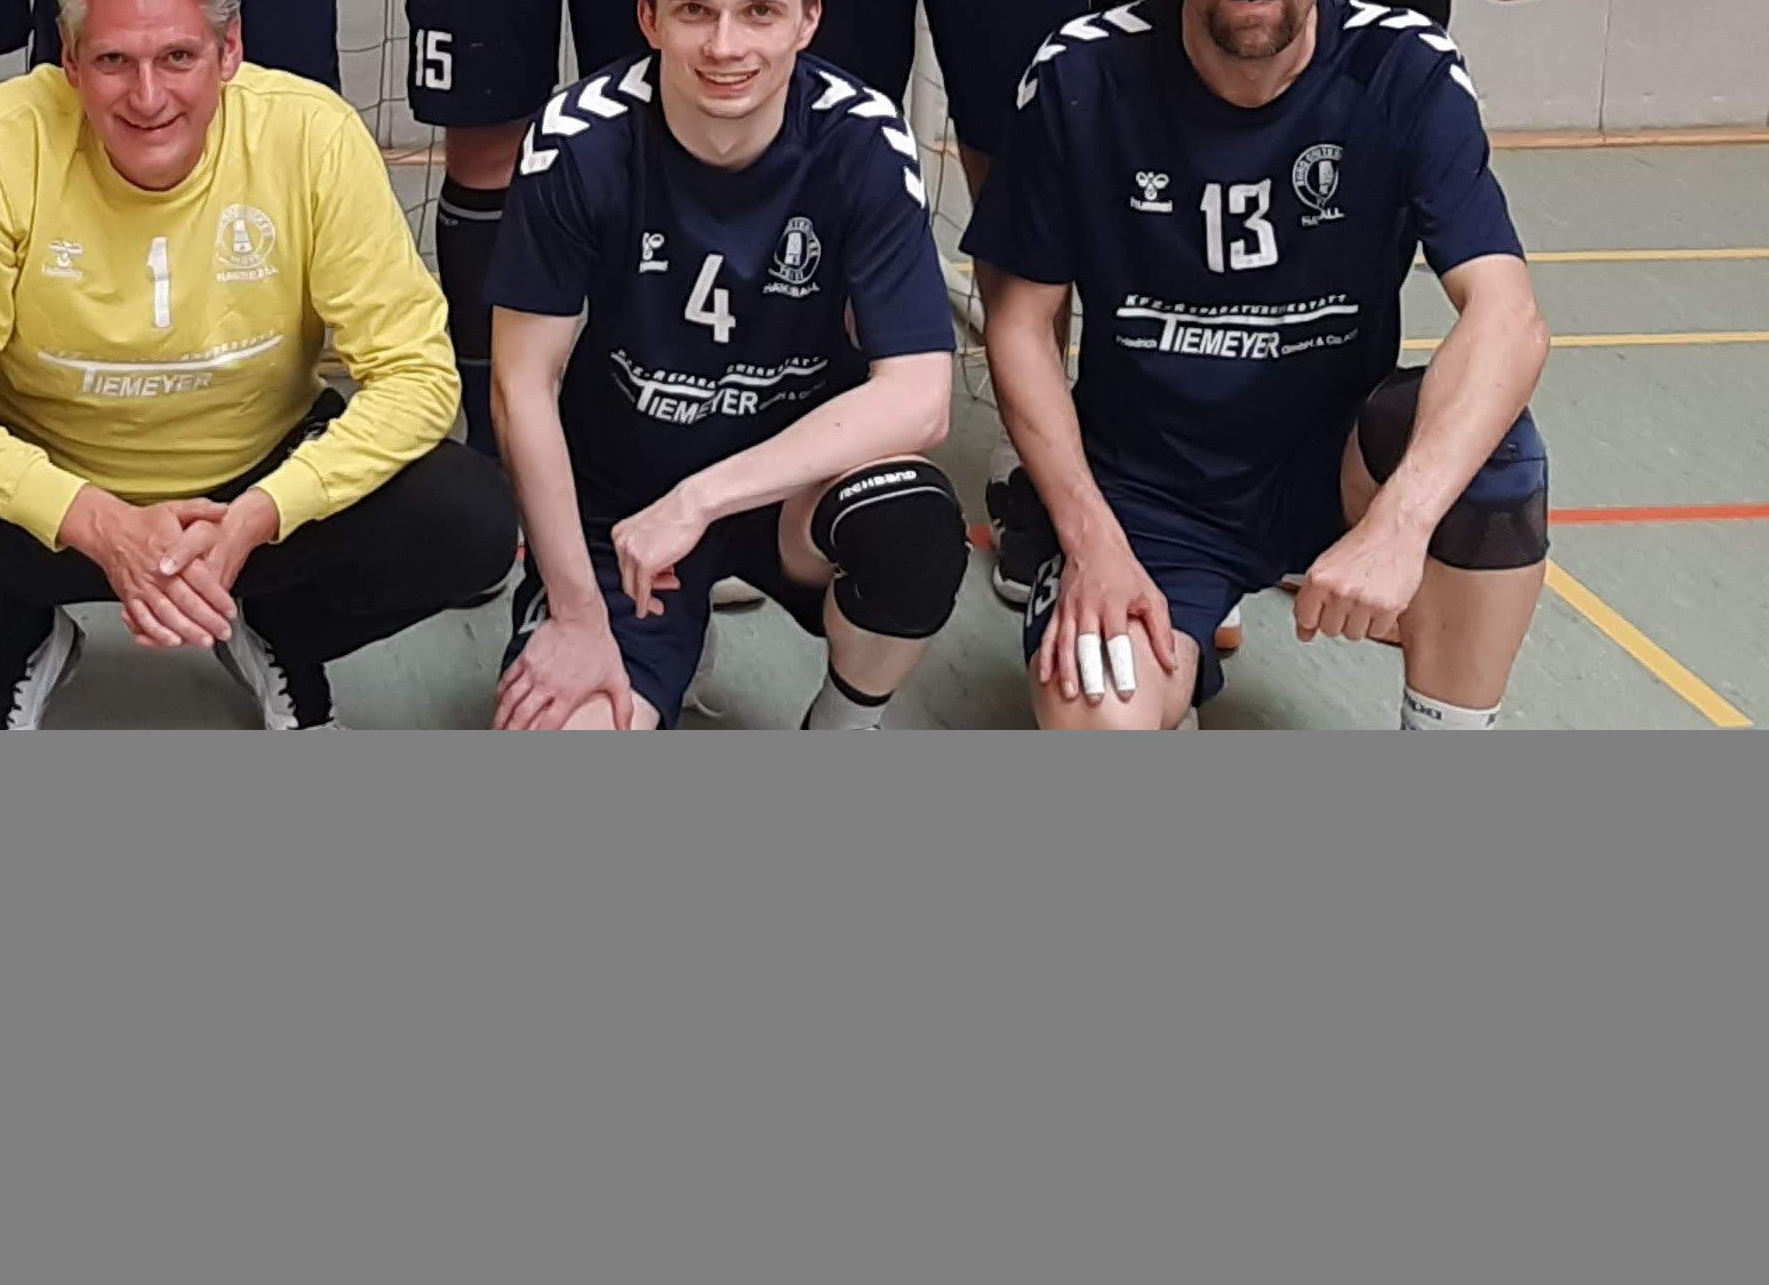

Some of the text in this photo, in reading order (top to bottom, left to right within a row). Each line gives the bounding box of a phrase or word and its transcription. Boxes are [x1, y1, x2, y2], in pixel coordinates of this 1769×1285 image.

[416, 29, 453, 90] 15
[1200, 177, 1279, 272] 13
[146, 236, 172, 328] 1
[684, 253, 736, 342] 4
[1159, 320, 1280, 359] TIEMEYER
[82, 371, 214, 397] TIEMEYER
[636, 386, 759, 425] TIEMEYER
